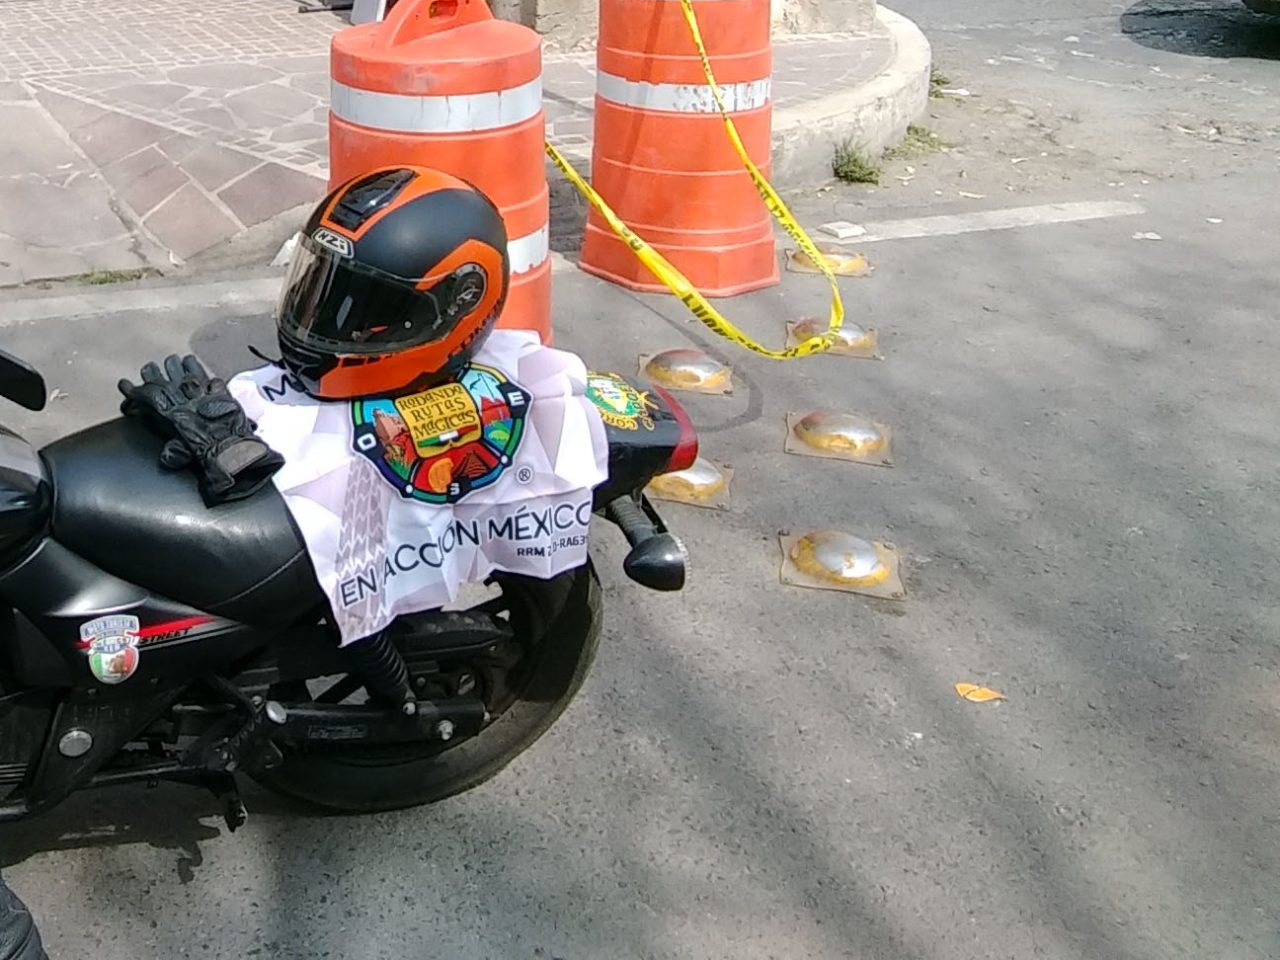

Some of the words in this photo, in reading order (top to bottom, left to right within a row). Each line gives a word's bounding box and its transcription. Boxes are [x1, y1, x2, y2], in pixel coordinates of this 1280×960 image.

[508, 391, 526, 407] E
[516, 545, 546, 558] RRM
[340, 567, 378, 607] EN
[384, 519, 480, 585] ACCIÓN
